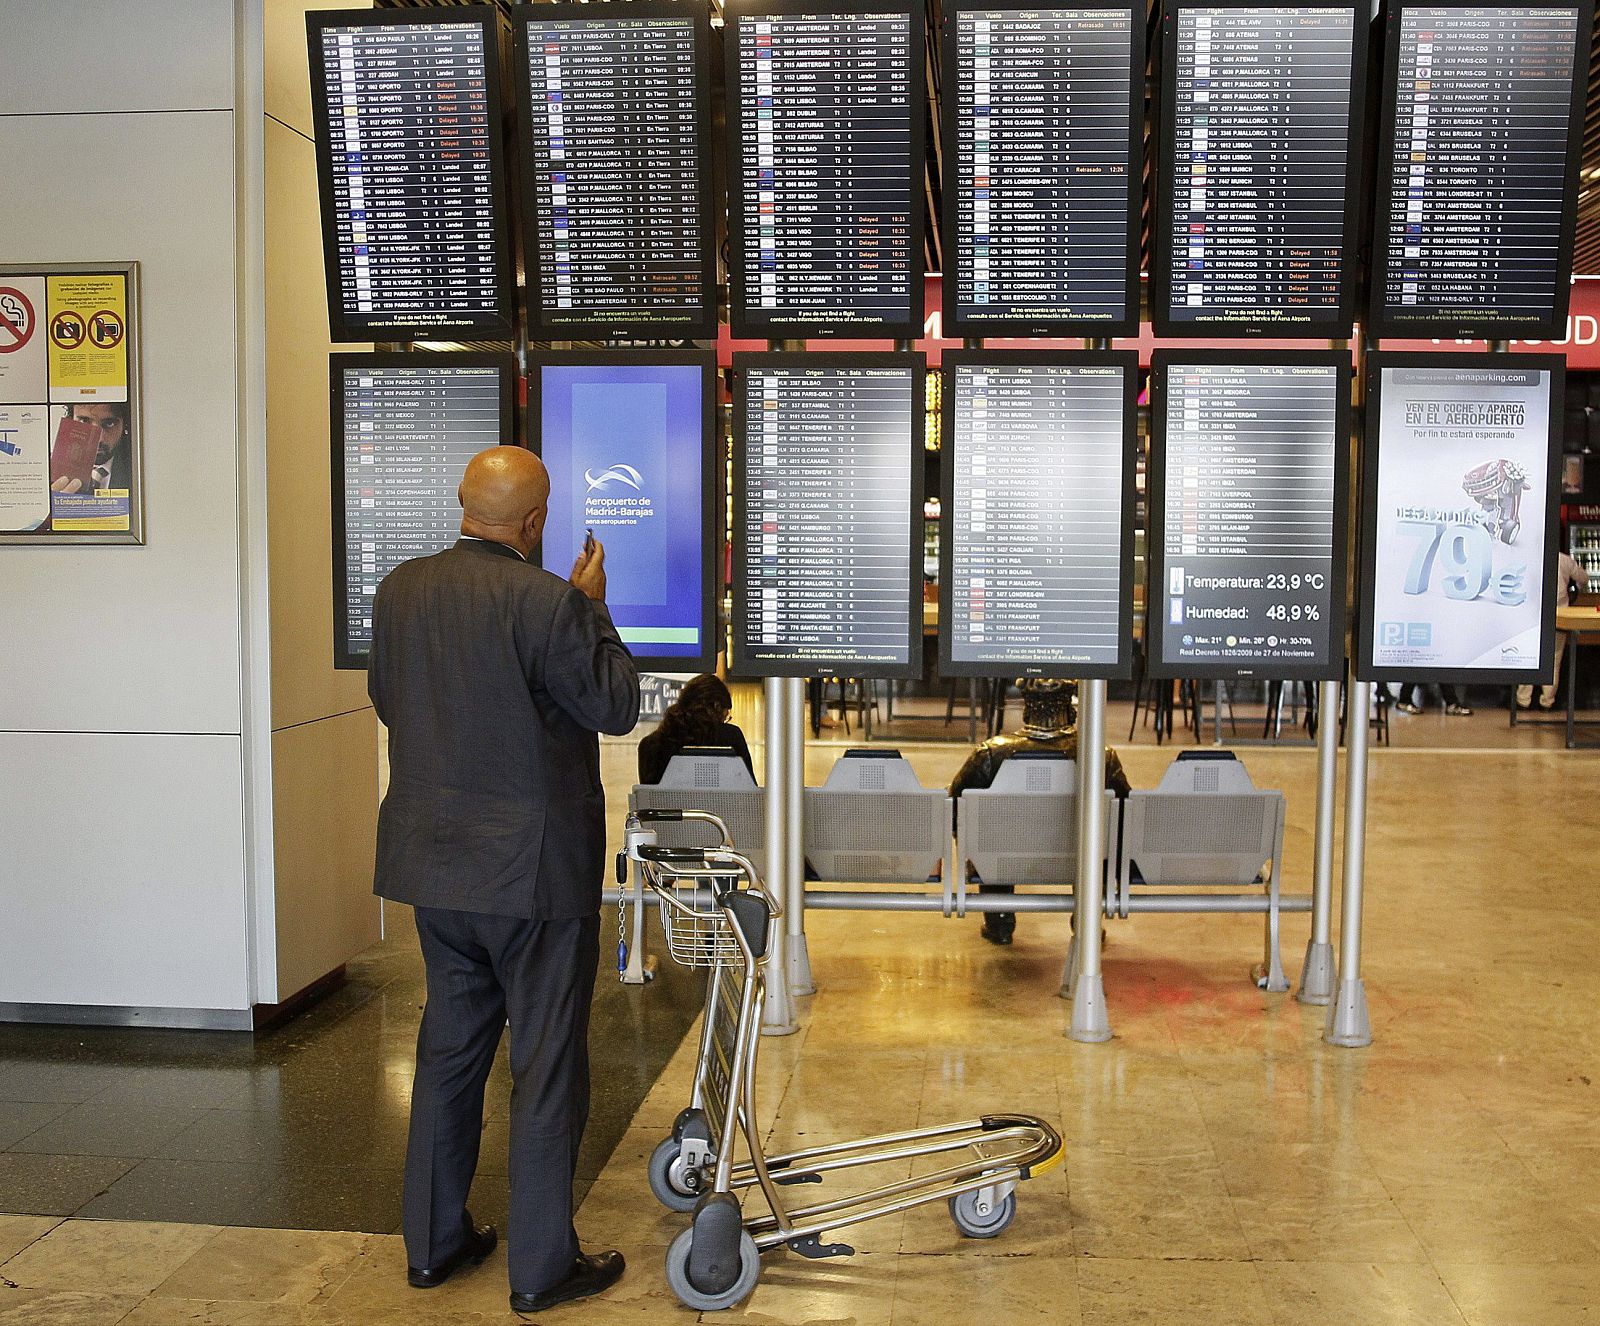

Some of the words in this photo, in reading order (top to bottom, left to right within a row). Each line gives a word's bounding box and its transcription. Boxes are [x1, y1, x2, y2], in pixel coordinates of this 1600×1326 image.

[1455, 374, 1526, 384] aenaparking.com
[1406, 403, 1424, 412] VEN
[1428, 403, 1439, 412] EN
[1444, 404, 1474, 413] COCHE
[1478, 404, 1484, 413] Y
[1487, 404, 1524, 413] APARCA
[1406, 413, 1421, 424] EN
[1427, 413, 1440, 424] EL
[1446, 413, 1524, 425] AEROPUERTO
[1414, 429, 1426, 437] Por
[1450, 430, 1473, 438] estará
[585, 497, 637, 506] Aeropuerto
[639, 497, 650, 505] de
[585, 508, 653, 517] Madrid-Barajas
[1185, 575, 1263, 588] Temperatura:
[1267, 574, 1300, 590] 23,9
[1186, 606, 1248, 618] Humedad:
[1266, 605, 1301, 621] 48,9
[1305, 605, 1319, 620] %
